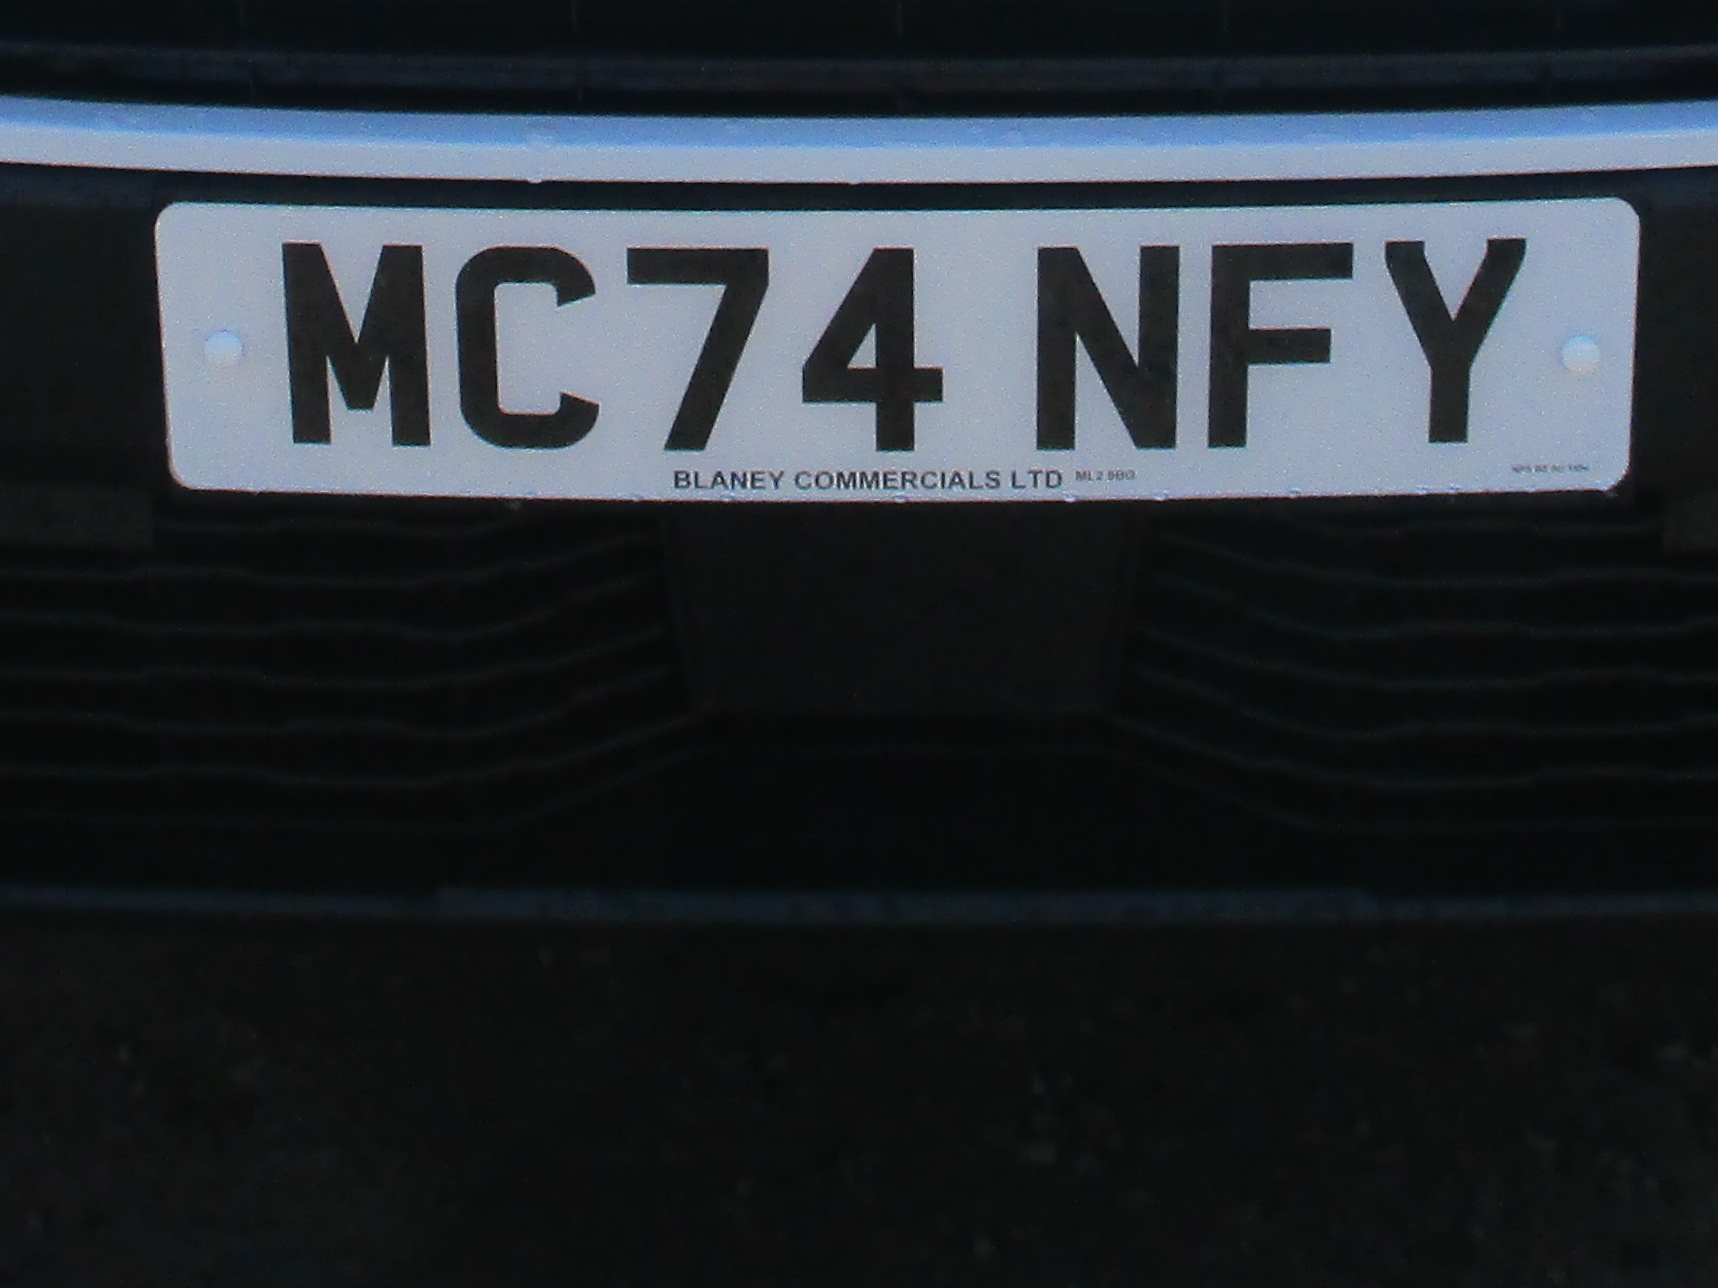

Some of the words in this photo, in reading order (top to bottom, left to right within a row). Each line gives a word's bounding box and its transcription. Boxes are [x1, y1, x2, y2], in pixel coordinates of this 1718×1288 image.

[281, 240, 944, 452] MC74
[1036, 237, 1527, 451] NFY
[674, 469, 784, 490] BLANEY
[794, 469, 1001, 491] COMMERCIALS
[1011, 469, 1063, 490] LTD
